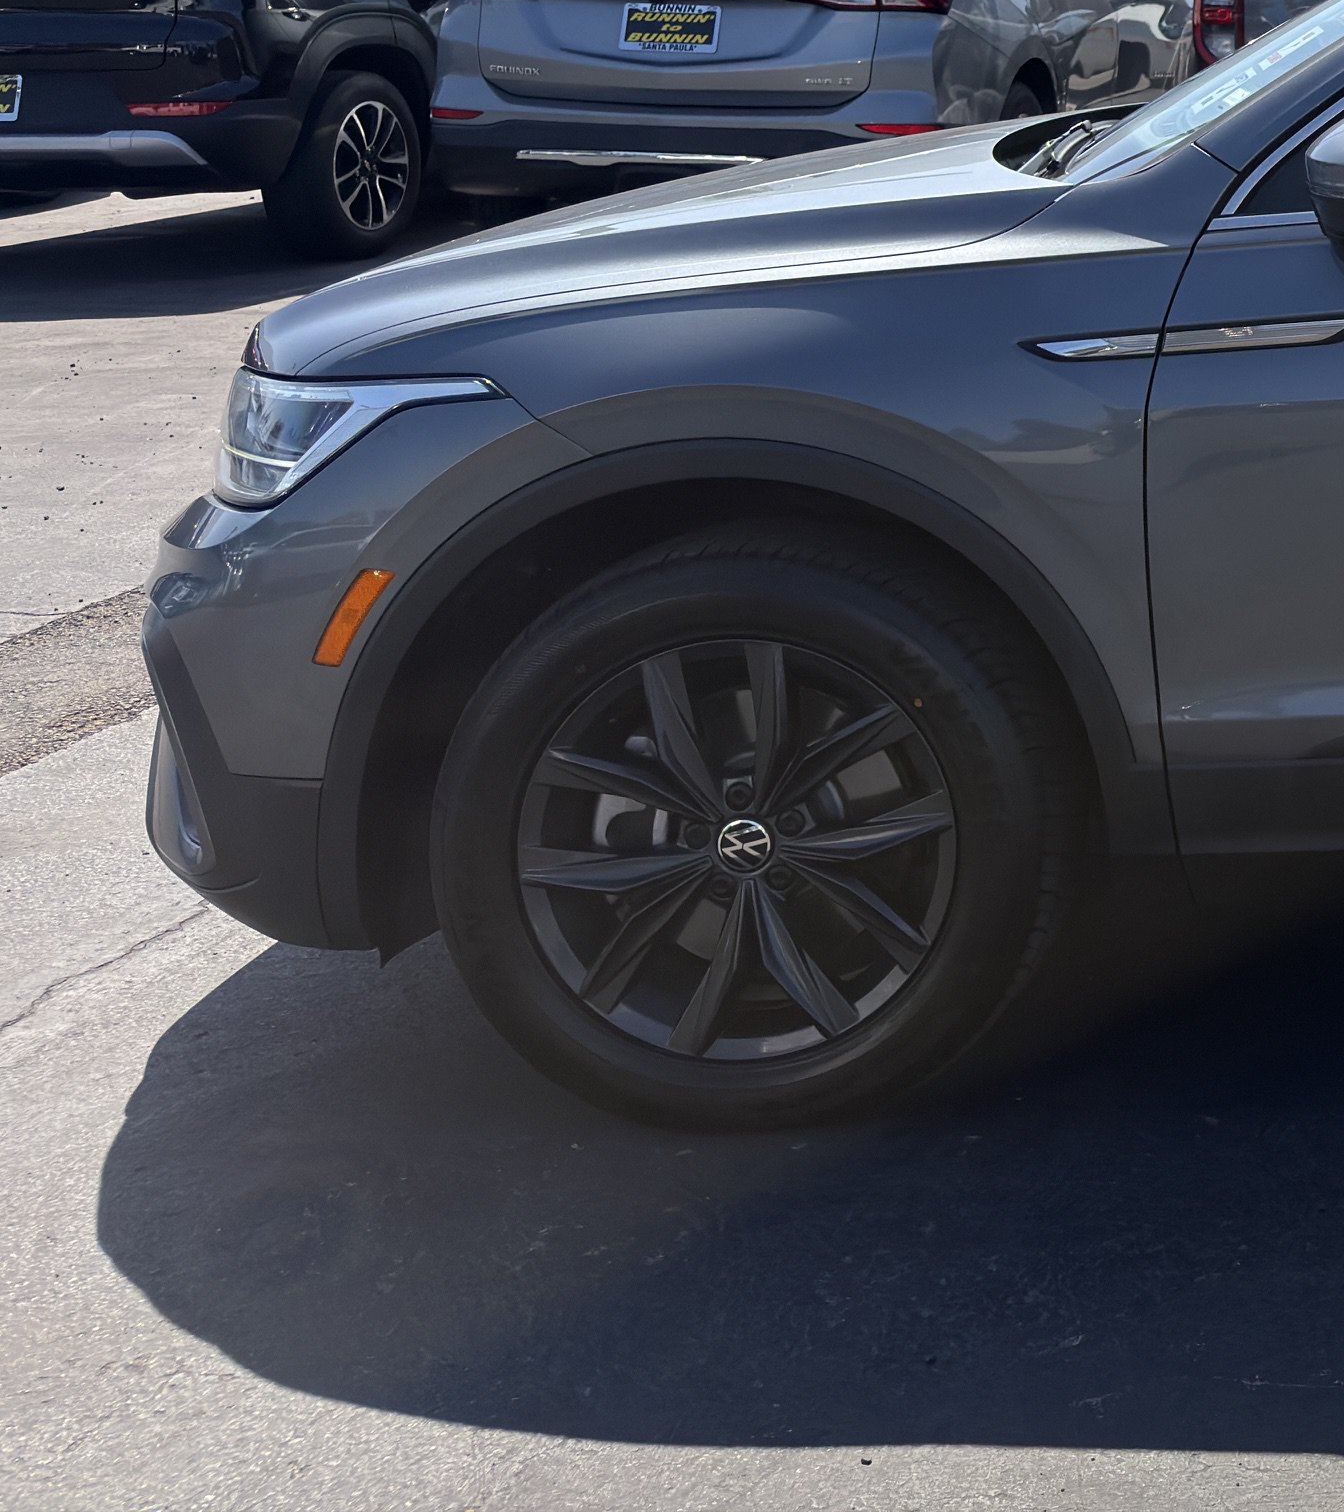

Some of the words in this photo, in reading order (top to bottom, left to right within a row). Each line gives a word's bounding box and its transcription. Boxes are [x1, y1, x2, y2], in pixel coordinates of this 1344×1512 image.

[649, 3, 696, 14] BUNNIN
[629, 12, 715, 23] RUNNIN'
[660, 23, 683, 31] to
[627, 32, 709, 43] BUNNIN
